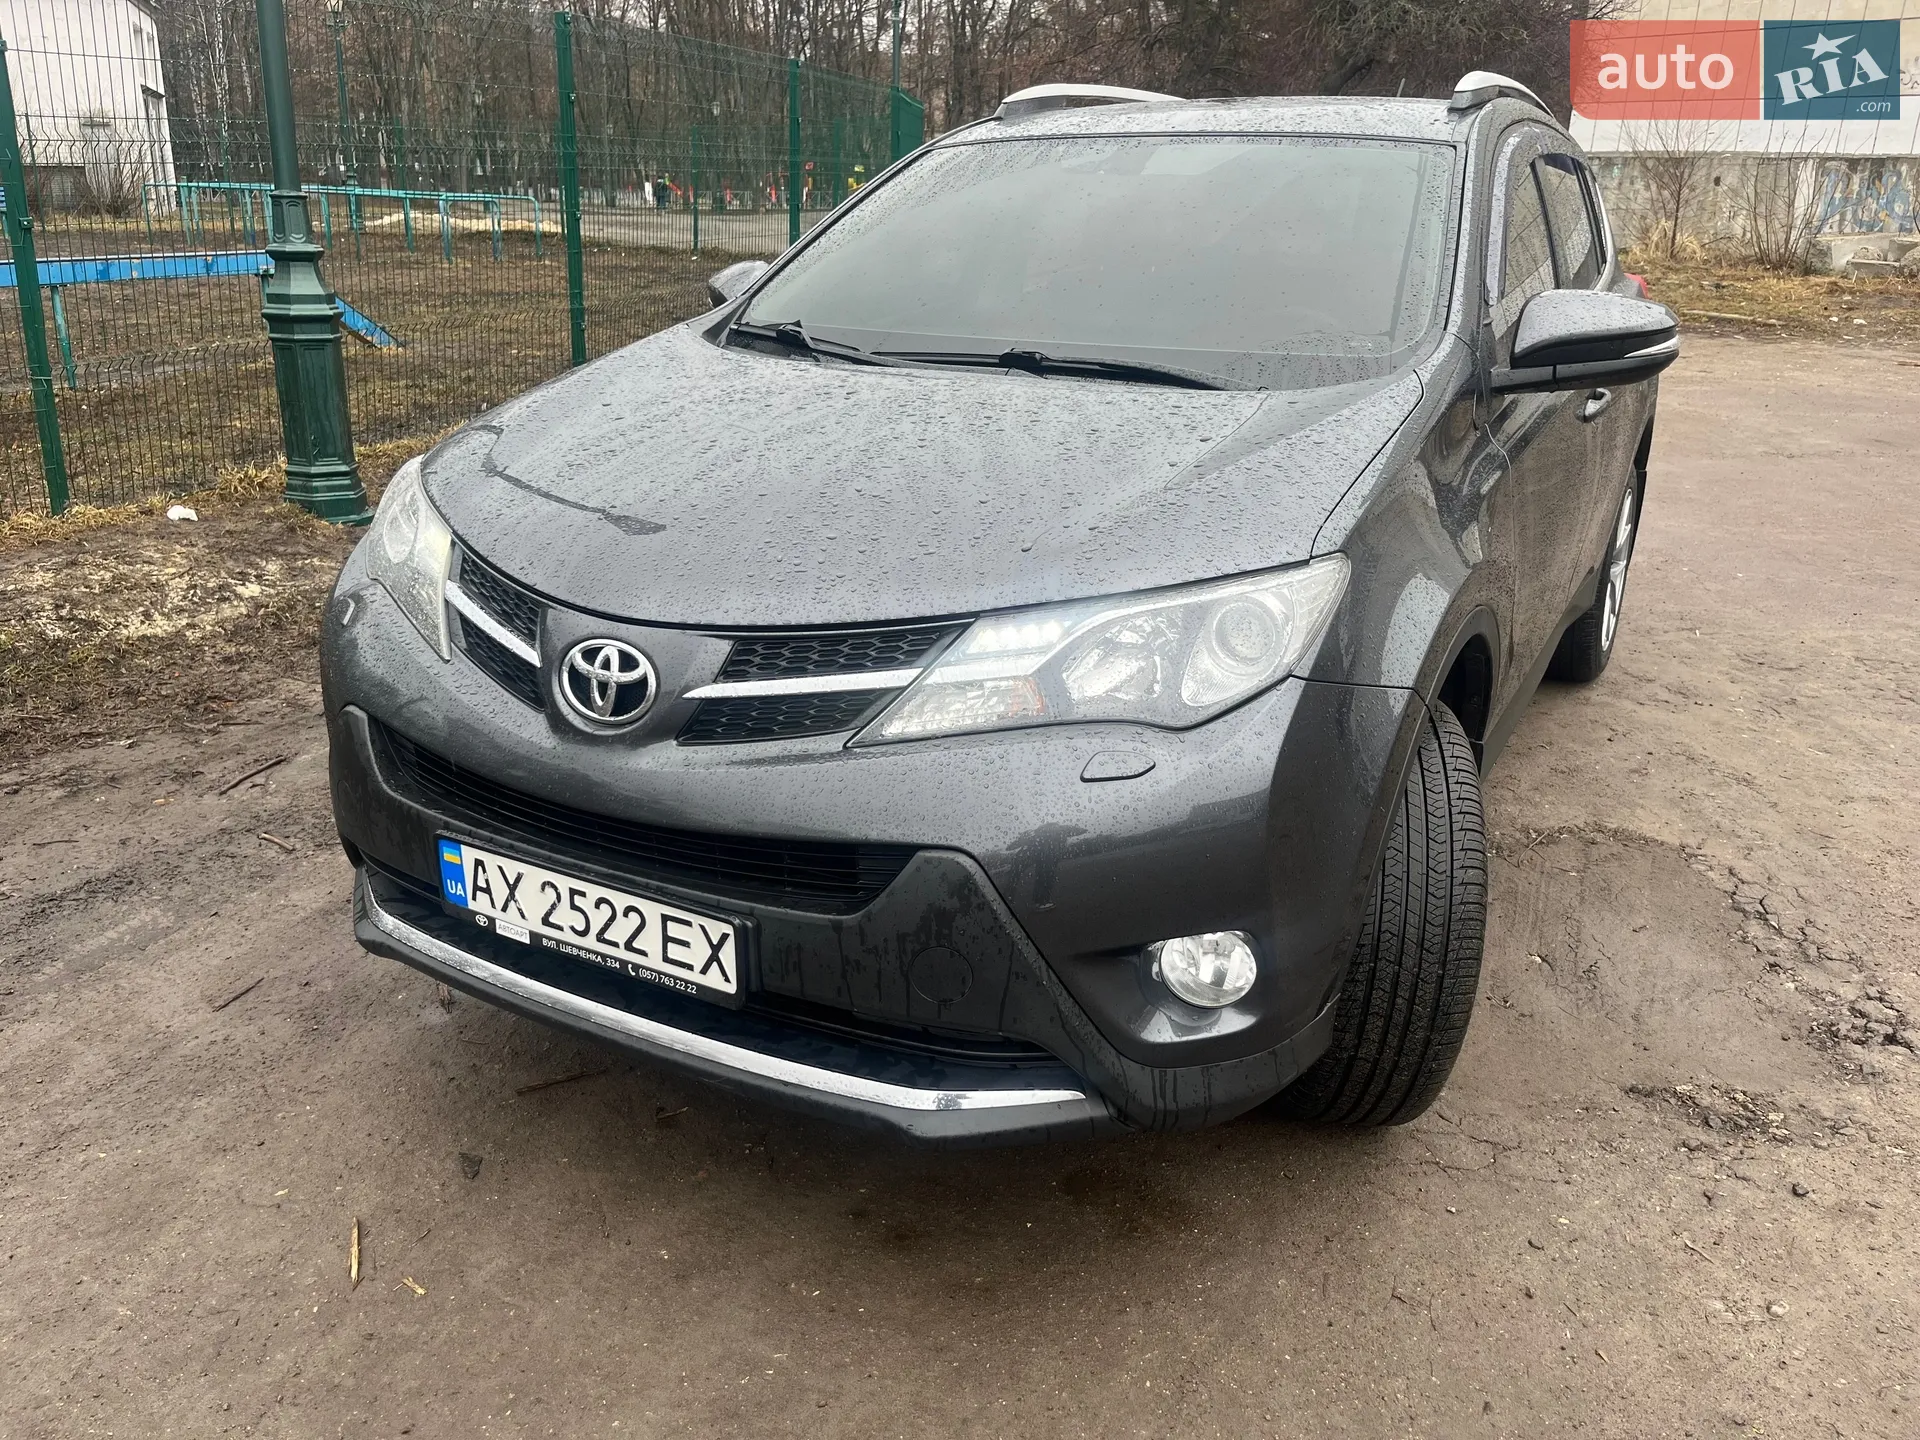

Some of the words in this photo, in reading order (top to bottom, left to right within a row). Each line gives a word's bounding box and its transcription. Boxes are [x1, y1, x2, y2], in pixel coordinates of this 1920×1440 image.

[448, 878, 465, 897] UA
[471, 857, 526, 920] AX
[540, 880, 649, 958] 2522
[660, 913, 731, 983] EX
[542, 937, 559, 950] ВУЛ.
[560, 943, 604, 964] ШЕВЧЕНКА,
[605, 957, 620, 969] 334
[639, 967, 659, 982] (057)
[660, 974, 675, 986] 763
[675, 979, 686, 990] 22
[686, 982, 697, 994] 22
